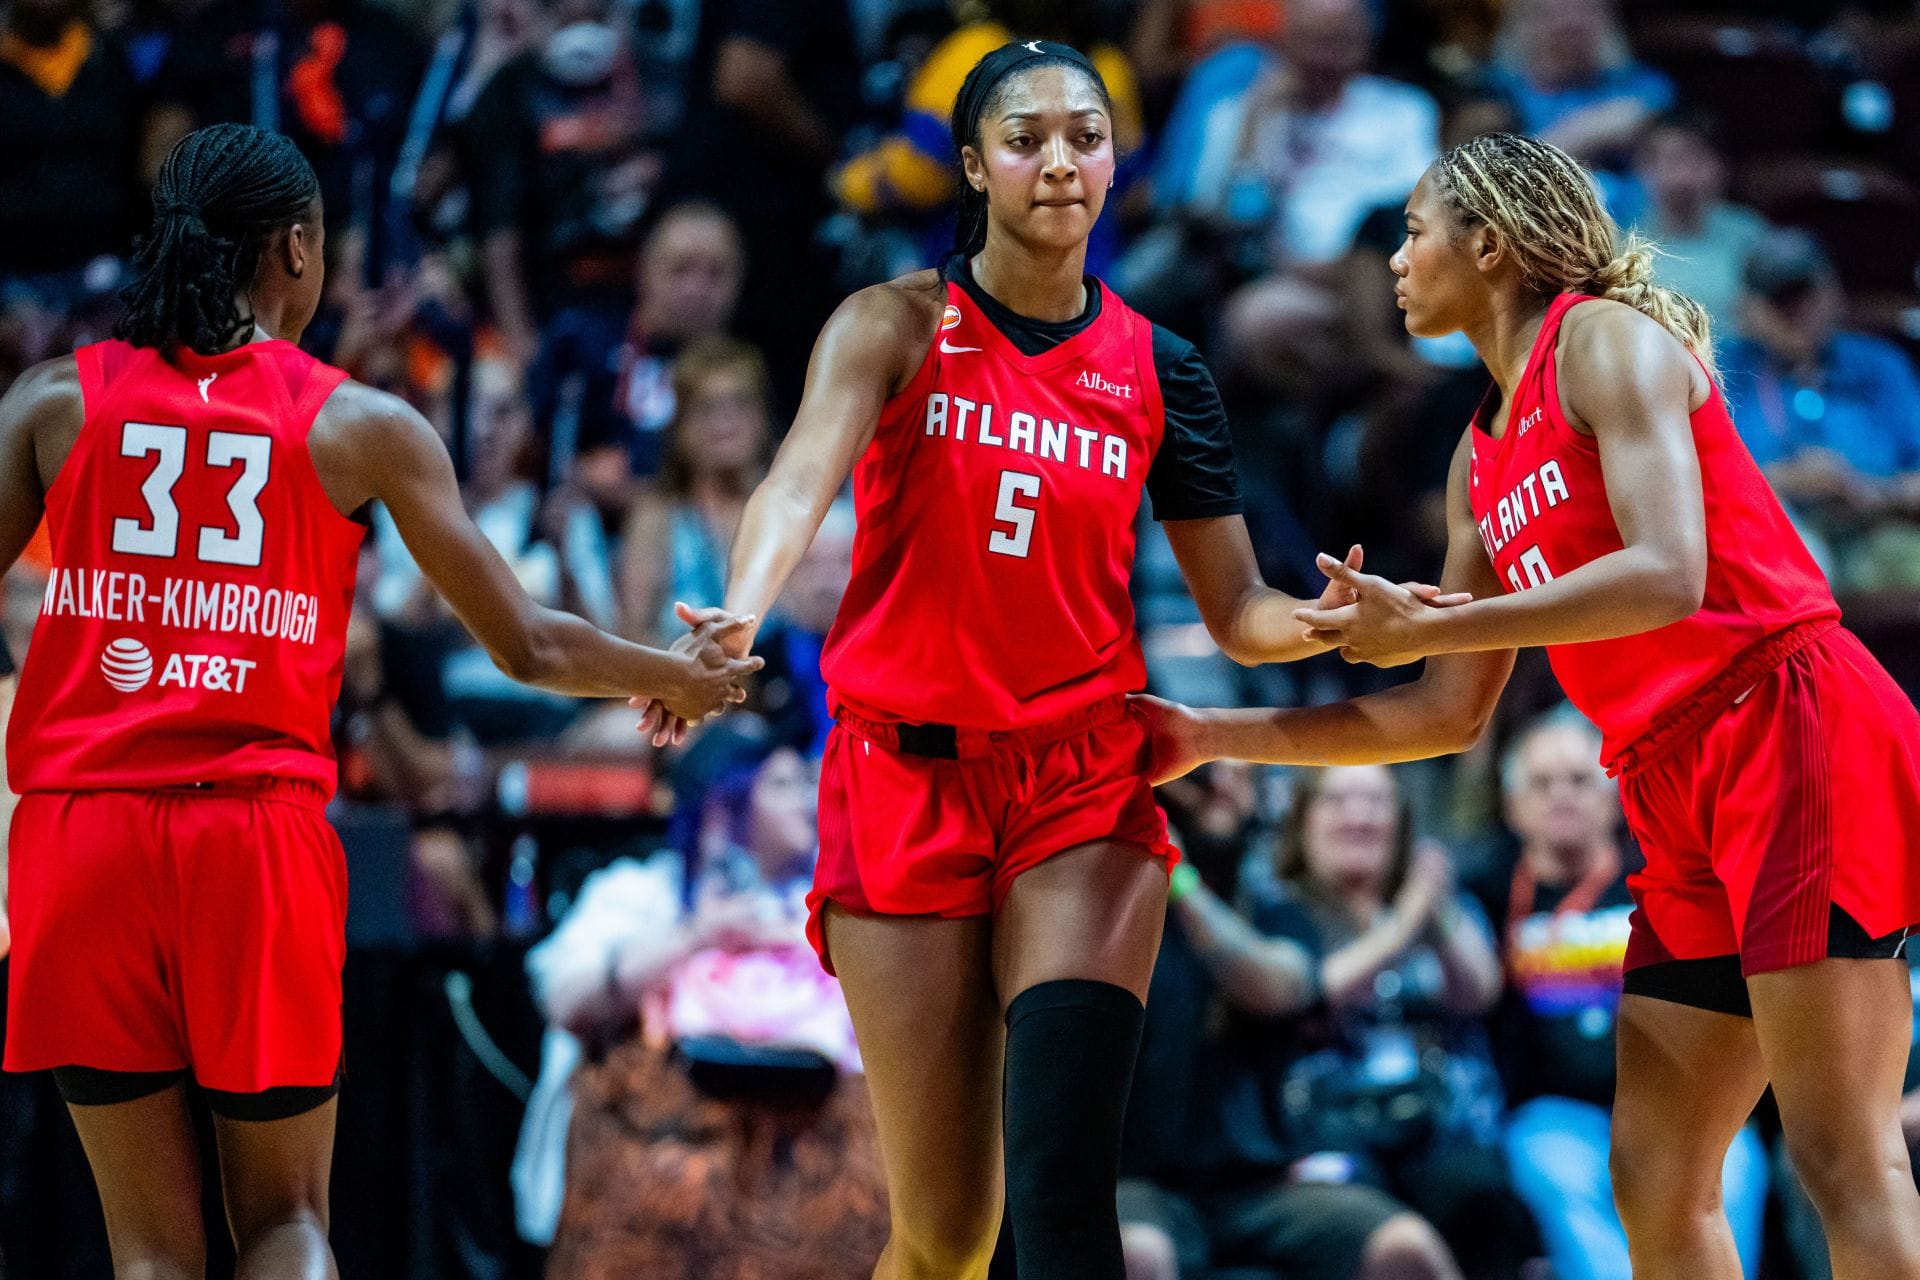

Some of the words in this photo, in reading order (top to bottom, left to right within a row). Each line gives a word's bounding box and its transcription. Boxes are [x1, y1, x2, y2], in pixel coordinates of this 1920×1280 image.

[1075, 370, 1132, 398] Albert
[925, 393, 1128, 480] ATLANTA
[112, 421, 272, 567] 33
[988, 470, 1041, 558] 5
[158, 653, 256, 694] AT&T
